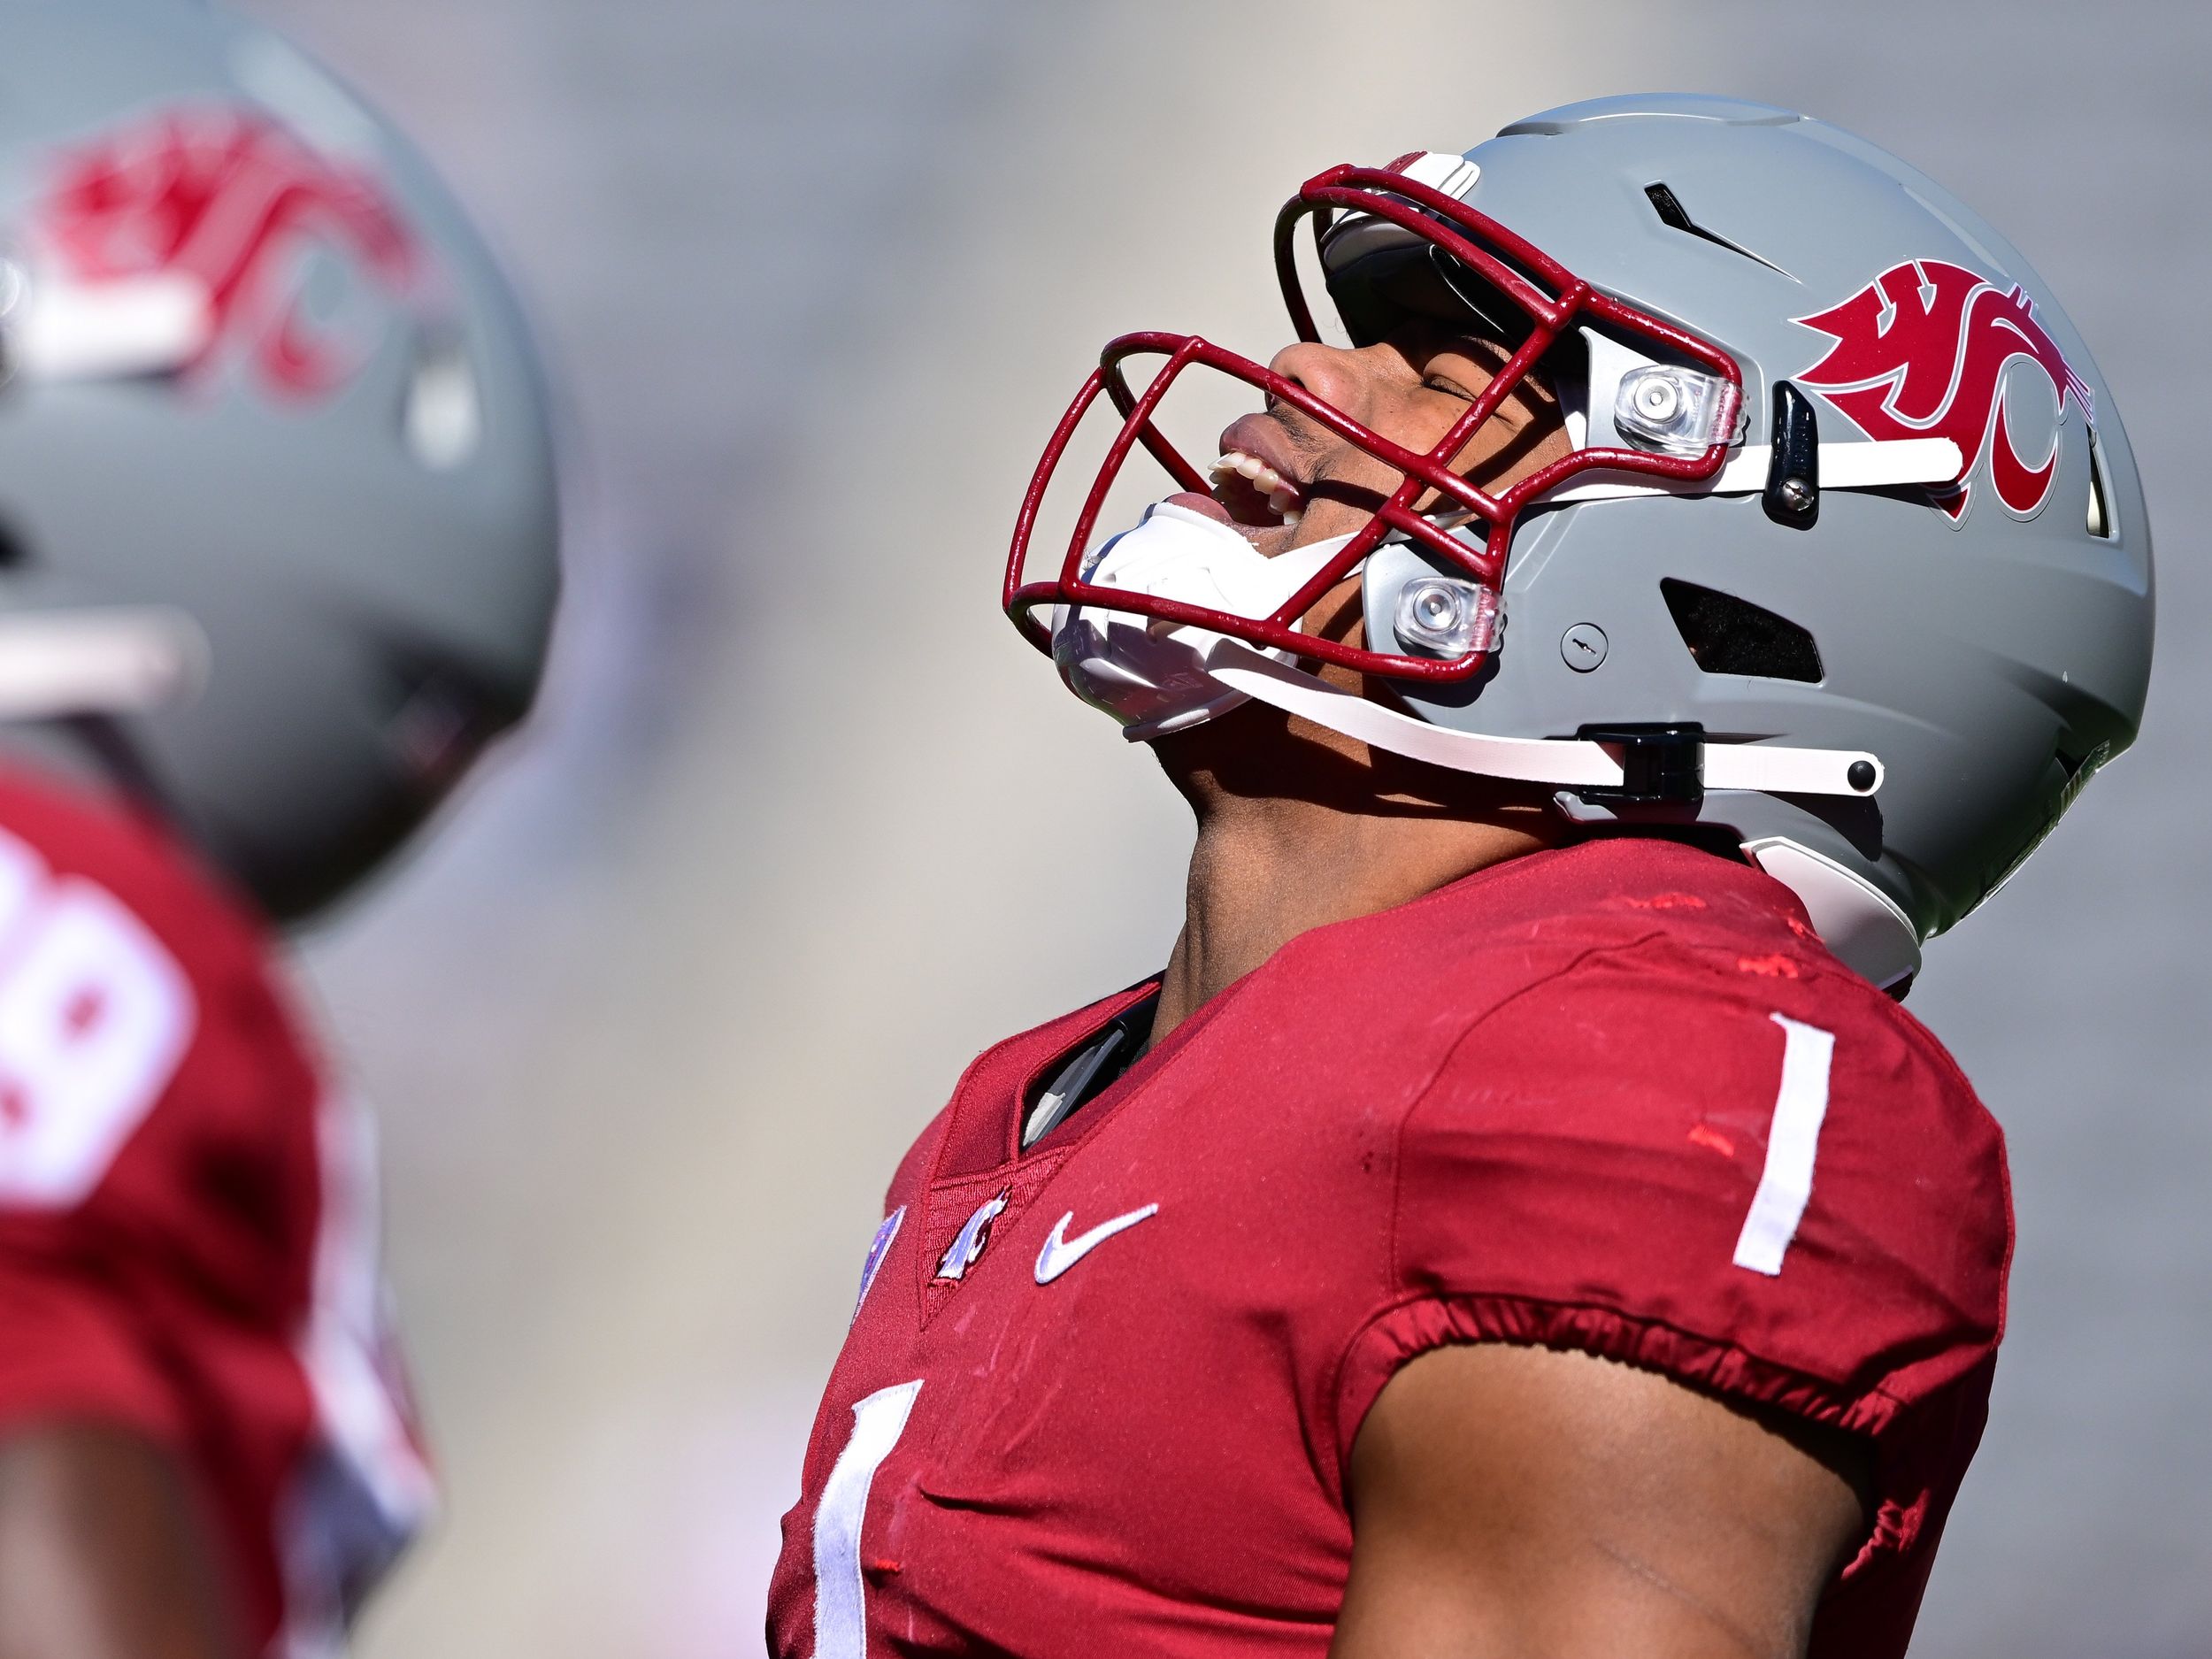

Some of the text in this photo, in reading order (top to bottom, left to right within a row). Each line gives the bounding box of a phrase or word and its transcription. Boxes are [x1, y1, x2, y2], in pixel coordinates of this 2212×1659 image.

[0, 832, 196, 1209] 9
[1732, 1012, 1836, 1276] 1
[811, 1379, 926, 1659] 1
